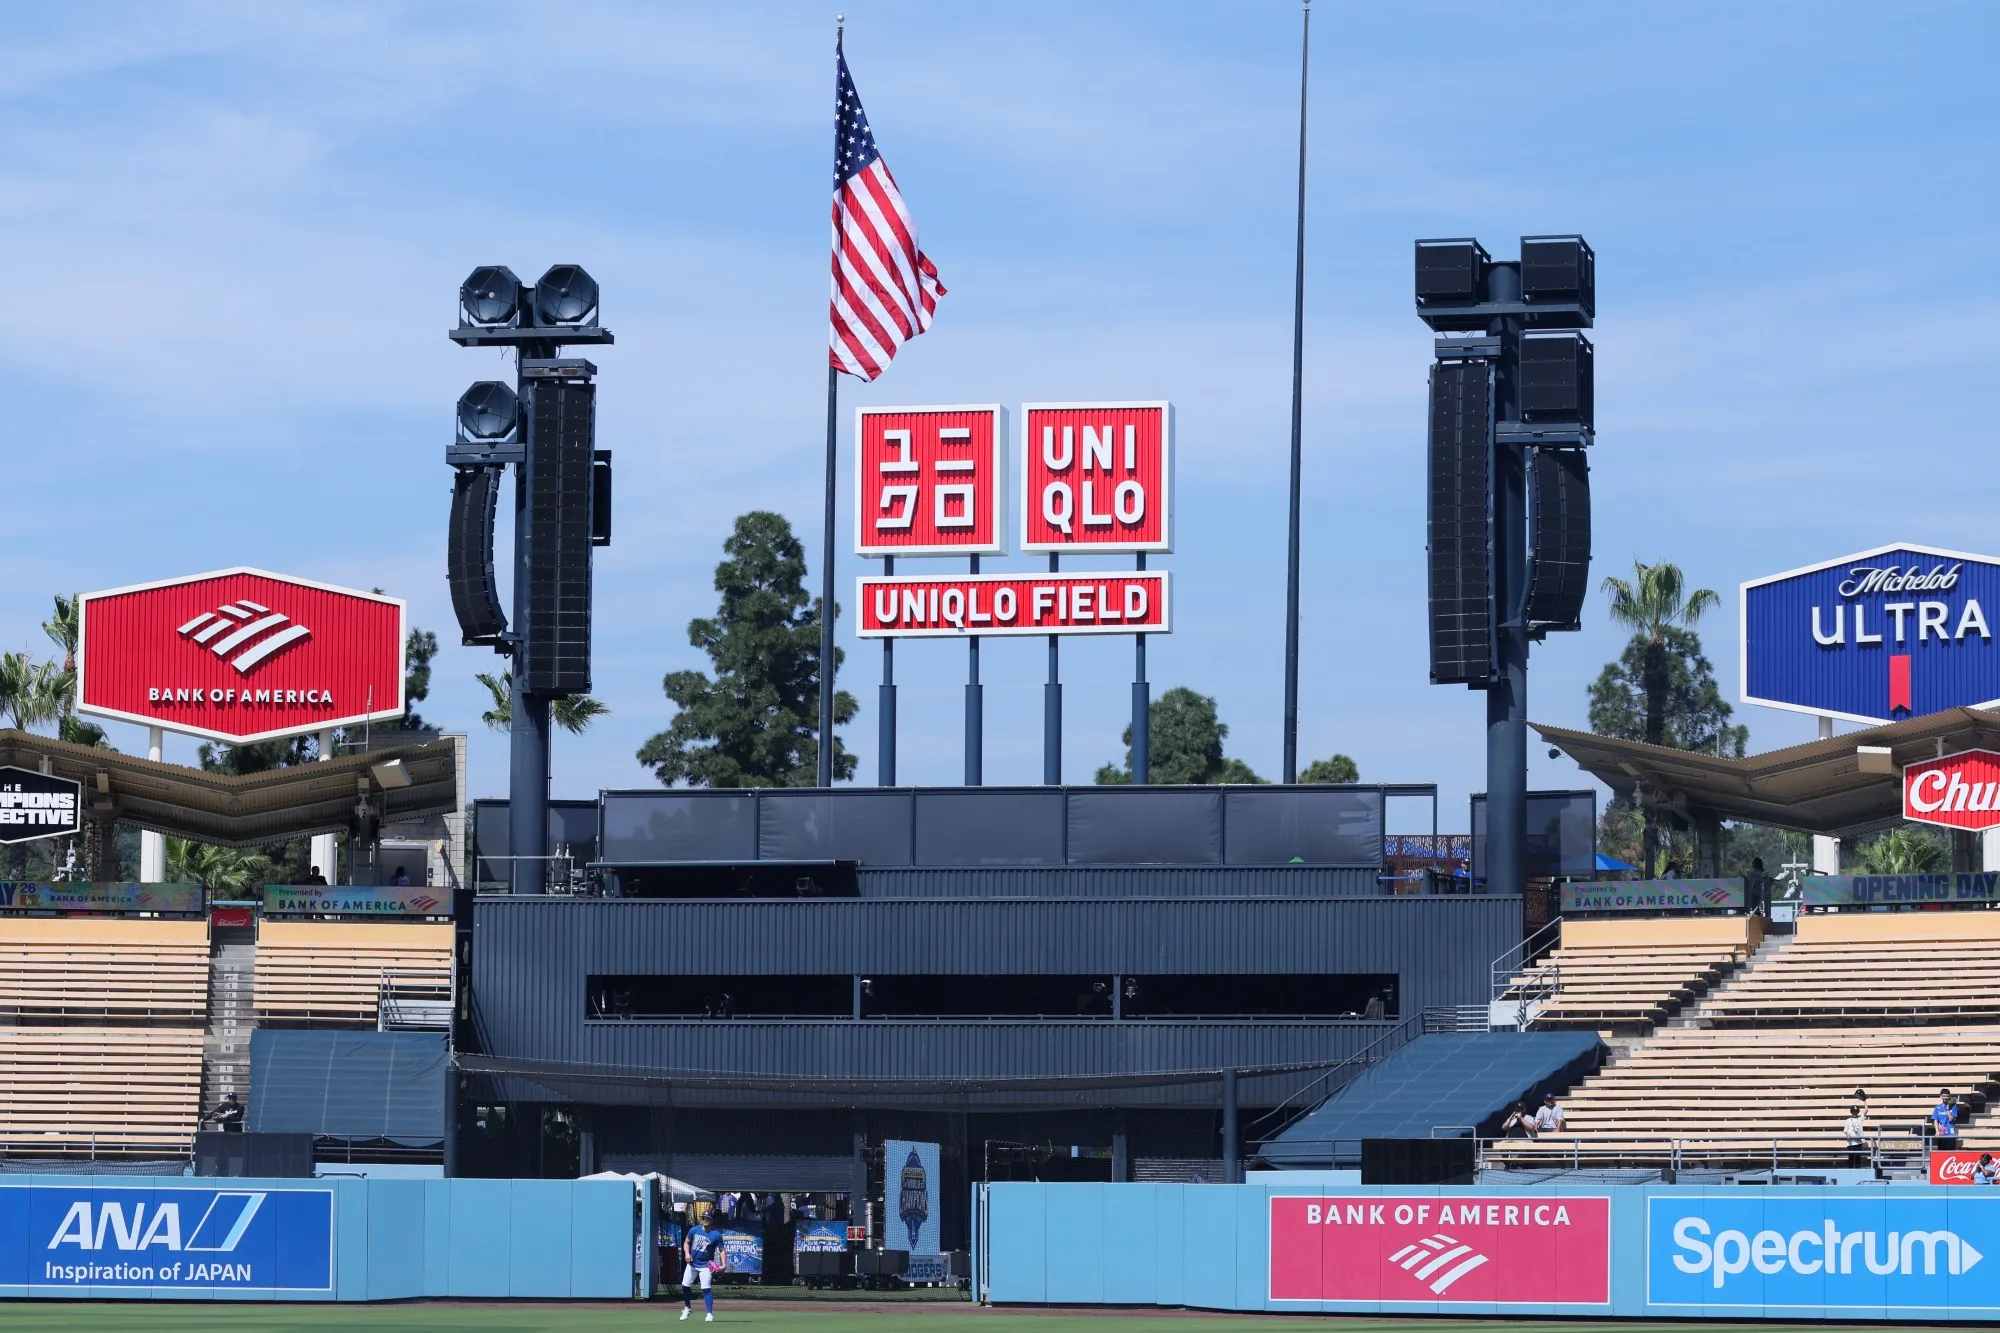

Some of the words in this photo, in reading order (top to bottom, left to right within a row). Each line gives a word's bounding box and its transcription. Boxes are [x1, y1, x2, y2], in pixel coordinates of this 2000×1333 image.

[1043, 424, 1136, 470] UNI
[1043, 480, 1145, 534] QLO
[1838, 563, 1962, 597] Michelob
[875, 587, 1018, 628] UNIQLO
[1032, 584, 1148, 620] FIELD
[1811, 599, 1991, 646] ULTRA
[149, 687, 204, 702] BANK
[209, 688, 236, 702] OF
[240, 689, 333, 703] AMERICA
[20, 882, 36, 894] 26
[278, 888, 313, 896] Presented
[1574, 886, 1607, 894] Presented
[1852, 874, 1949, 901] OPENING
[1956, 873, 1998, 899] DAY
[50, 894, 75, 902] BANK
[77, 895, 89, 903] OF
[91, 895, 132, 903] AMERICA
[278, 899, 317, 910] BANK
[320, 900, 339, 911] OF
[342, 900, 407, 911] AMERICA
[1574, 897, 1612, 908] BANK
[1615, 896, 1632, 906] OF
[1635, 894, 1699, 906] AMERICA
[47, 1201, 183, 1251] ANA
[1307, 1204, 1386, 1225] BANK
[1394, 1204, 1431, 1225] OF
[1437, 1205, 1571, 1226] AMERICA
[1672, 1216, 1960, 1289] Spectrum
[46, 1261, 154, 1283] Inspiration
[159, 1261, 181, 1281] of
[184, 1263, 251, 1282] JAPAN
